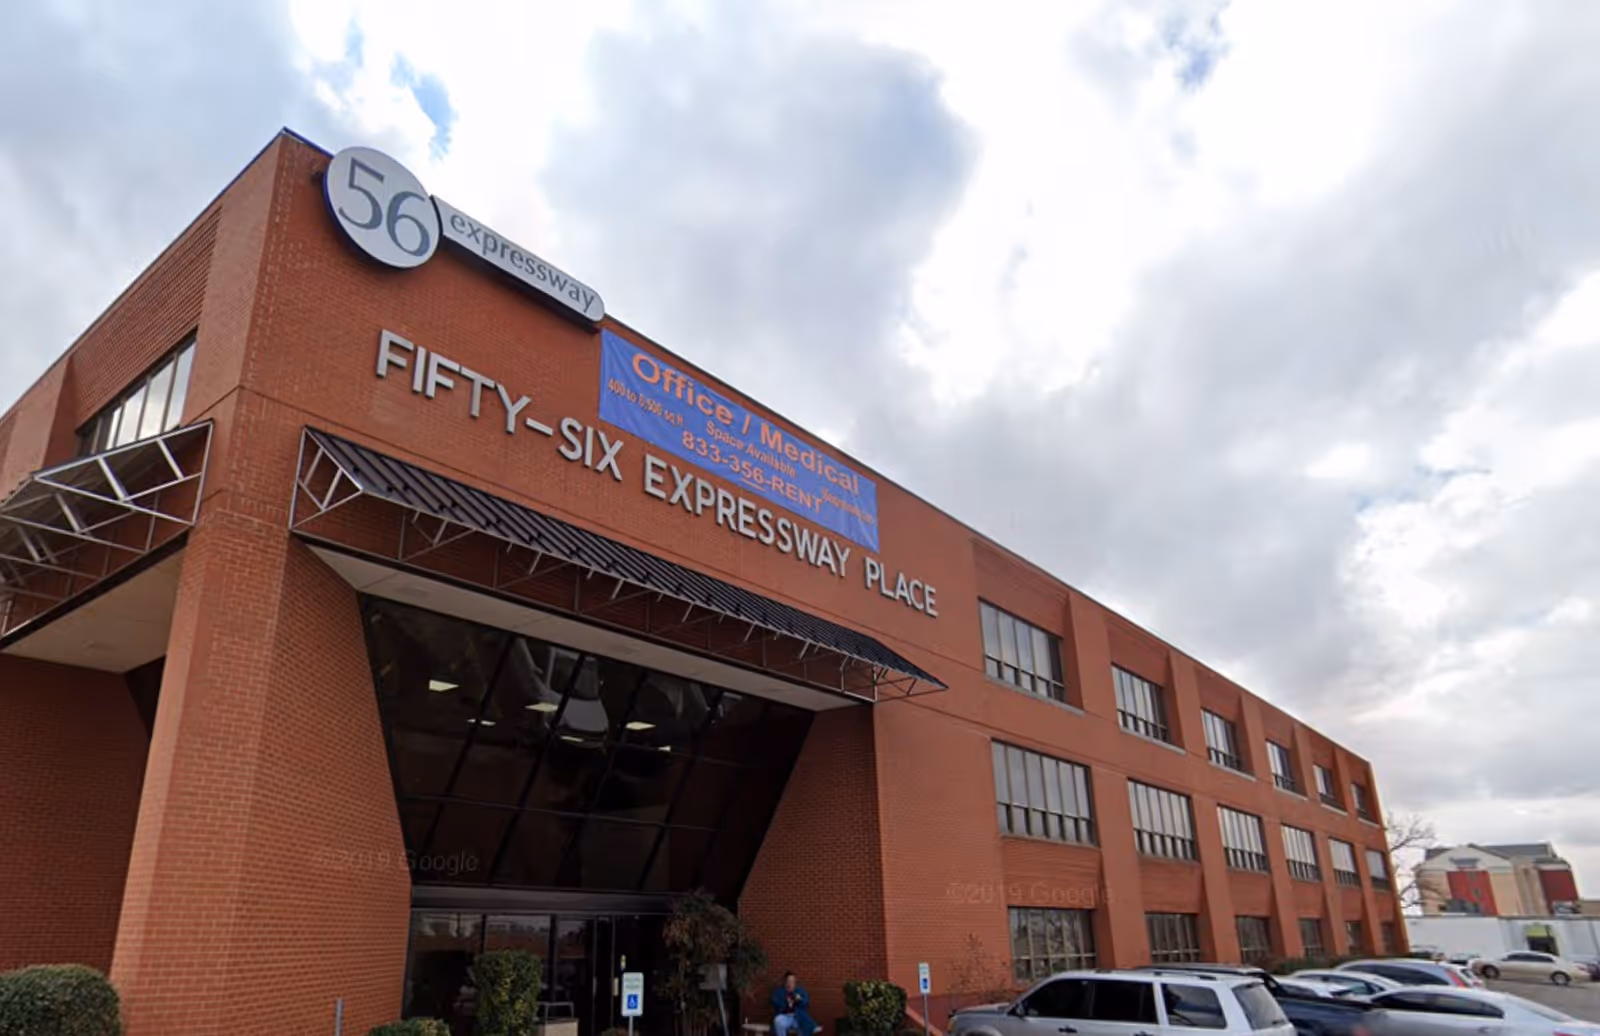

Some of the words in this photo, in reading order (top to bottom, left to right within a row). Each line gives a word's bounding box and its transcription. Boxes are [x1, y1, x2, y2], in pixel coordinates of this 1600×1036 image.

[339, 157, 431, 257] 56
[451, 212, 595, 313] expressway
[375, 328, 624, 482] FIFTY-SIX
[643, 453, 851, 578] EXPRESSWAY
[863, 556, 939, 618] PLACE
[632, 353, 733, 425] Office
[742, 414, 751, 435] /
[761, 422, 859, 495] Medical
[682, 430, 823, 513] 833-356-RENT
[706, 420, 744, 450] Space
[745, 443, 797, 479] Available
